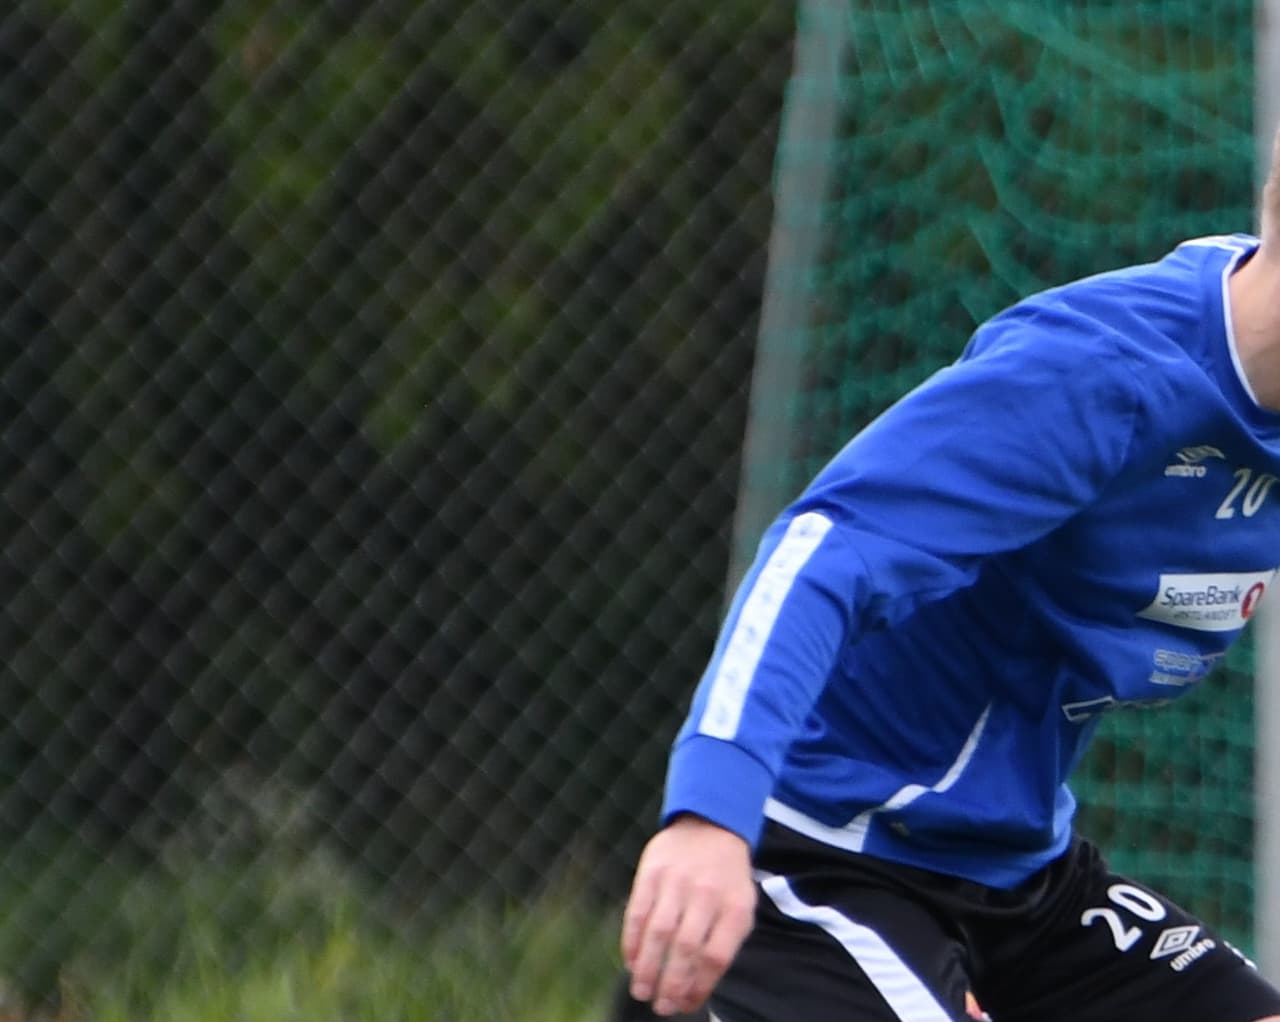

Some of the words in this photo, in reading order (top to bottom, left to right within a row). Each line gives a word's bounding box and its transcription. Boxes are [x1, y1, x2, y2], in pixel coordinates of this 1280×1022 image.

[1215, 468, 1280, 519] 20
[1160, 585, 1242, 608] SpareBank
[1081, 884, 1166, 952] 20
[1170, 937, 1216, 972] umbro
